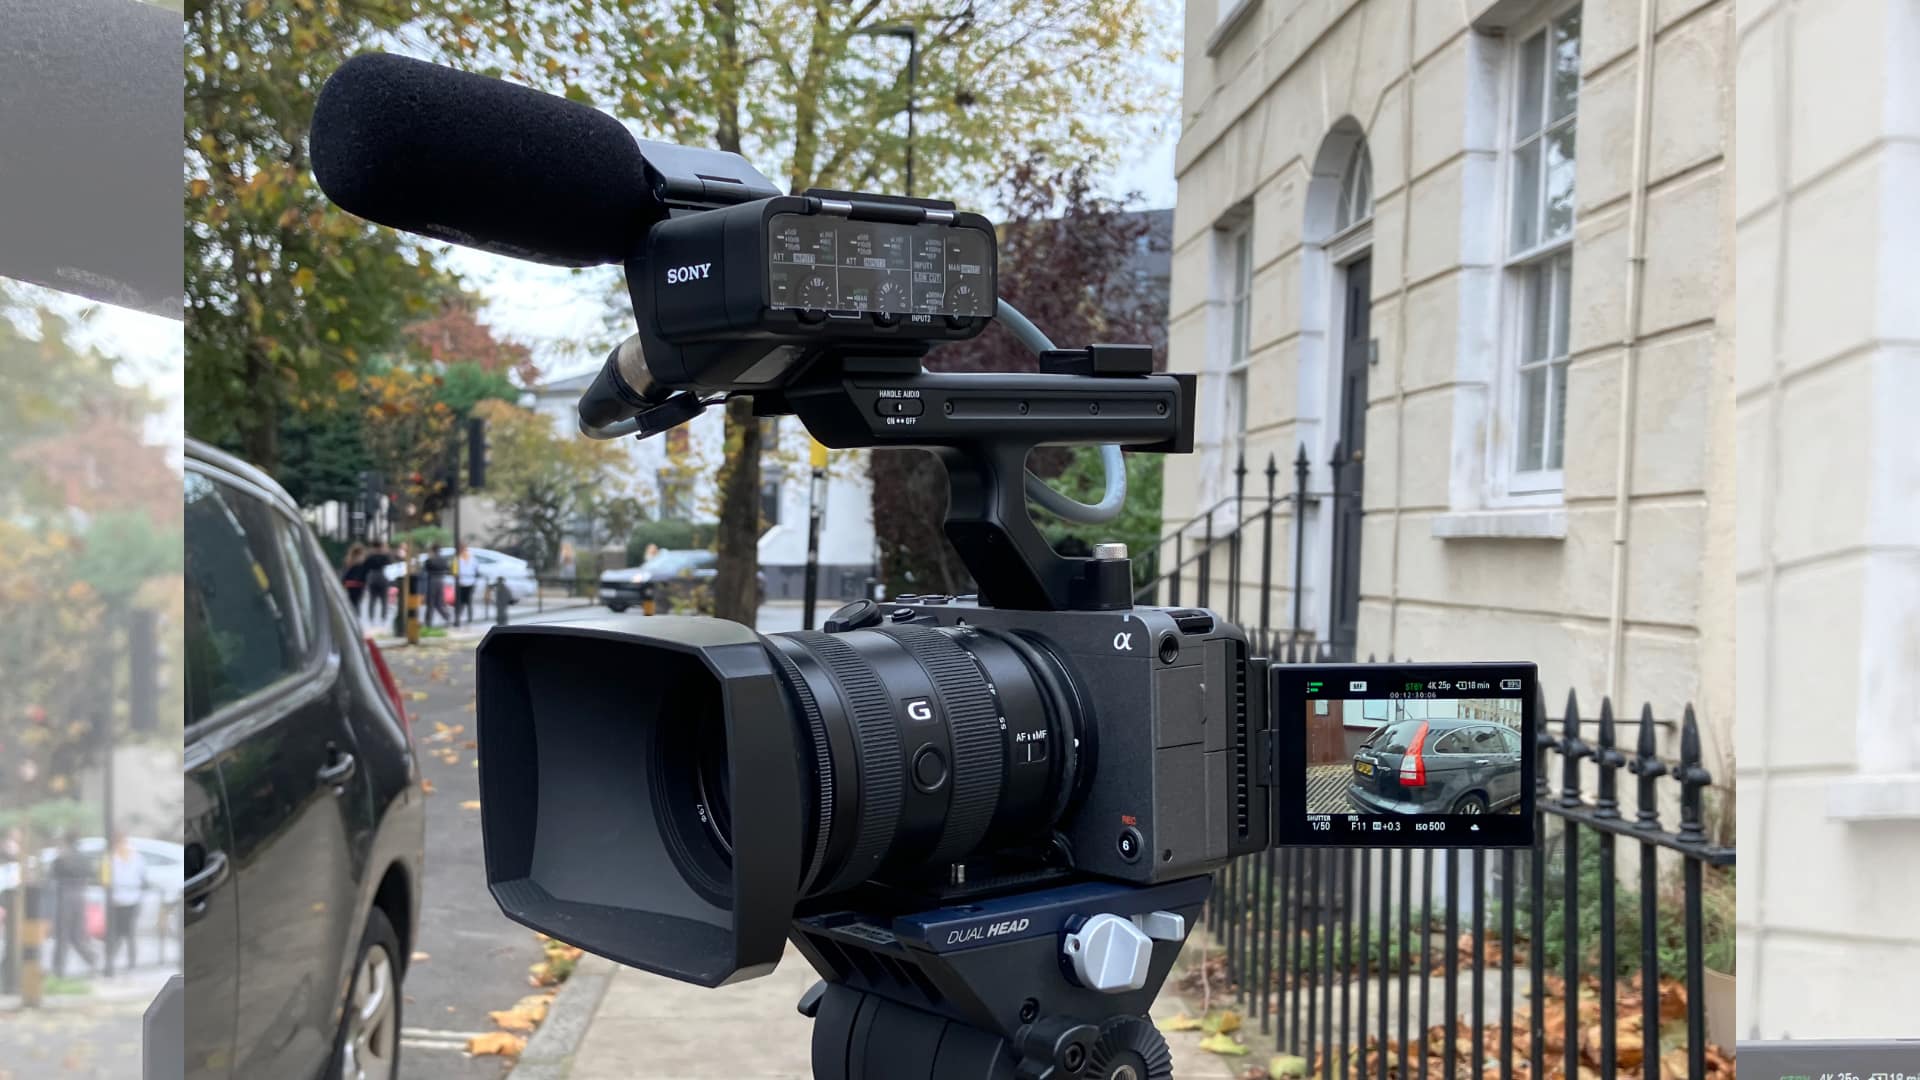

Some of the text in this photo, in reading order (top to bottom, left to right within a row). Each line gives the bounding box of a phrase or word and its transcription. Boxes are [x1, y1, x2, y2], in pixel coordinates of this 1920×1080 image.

[773, 252, 785, 262] ATT
[845, 256, 857, 265] ATT
[667, 262, 712, 285] SONY
[911, 314, 931, 323] INPUT2
[879, 389, 920, 399] HANDLE AUDIO
[886, 416, 917, 425] ON OFF
[1427, 681, 1438, 690] 4K
[1438, 681, 1452, 692] 25p
[1477, 680, 1490, 690] min
[907, 700, 932, 720] G
[1016, 729, 1048, 742] AF MF
[1312, 821, 1331, 831] 1/50
[1351, 821, 1366, 831] F11
[1382, 821, 1401, 831] +0.3
[1415, 821, 1446, 831] ISO 500
[1122, 839, 1130, 851] 6
[946, 918, 1030, 945] DUAL HEAD
